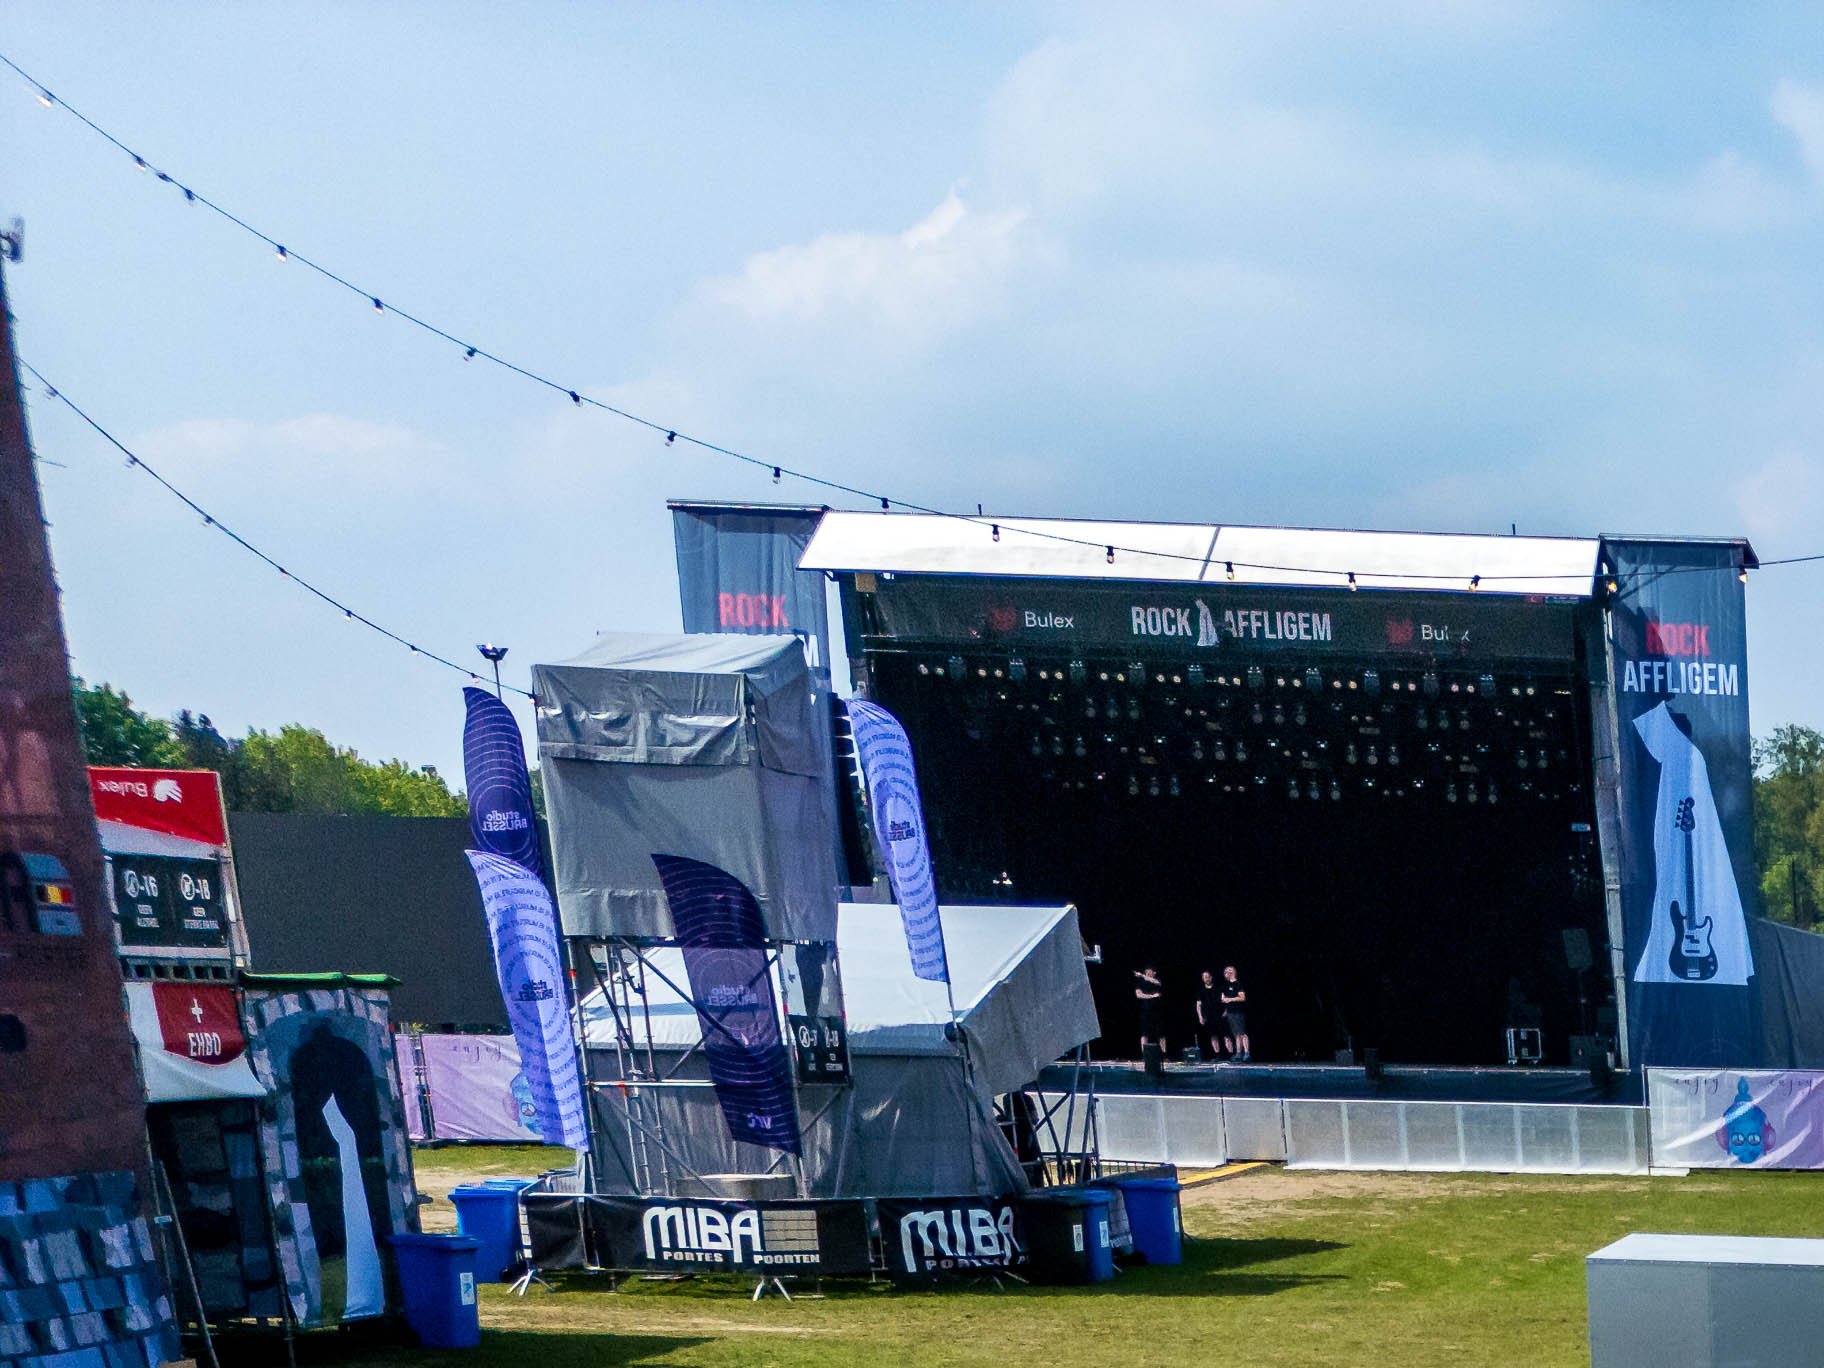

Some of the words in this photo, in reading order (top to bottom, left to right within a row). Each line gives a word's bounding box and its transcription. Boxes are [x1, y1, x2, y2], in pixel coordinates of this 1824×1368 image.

[718, 592, 789, 627] ROCK
[1025, 611, 1075, 629] Bulex
[1131, 606, 1192, 637] ROCK
[1223, 610, 1332, 641] AFFLIGEM
[1645, 620, 1710, 656] ROCK
[1623, 660, 1739, 696] AFFLIGEM
[187, 1032, 222, 1056] EHBO
[642, 1206, 762, 1263] MIBA
[901, 1206, 1021, 1273] MIBA
[663, 1250, 723, 1263] PORTES
[753, 1253, 821, 1265] POORTEN
